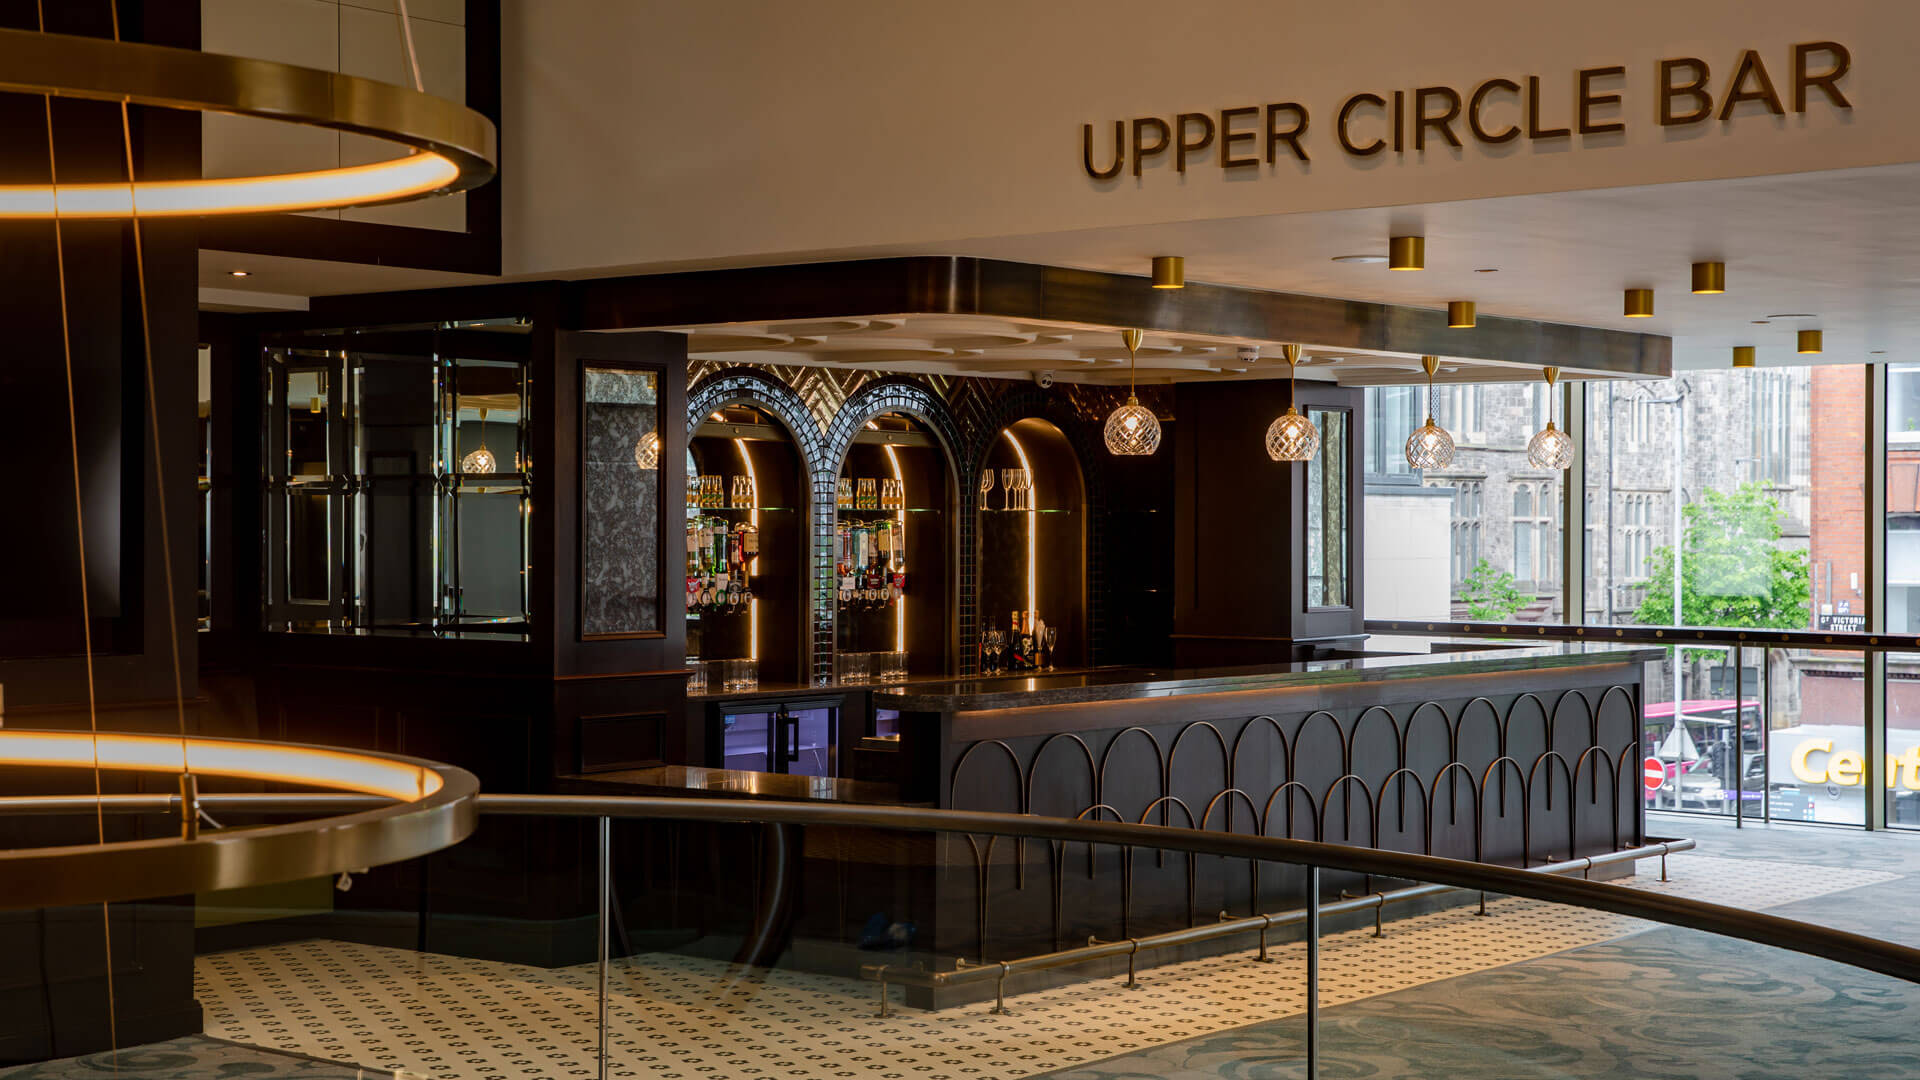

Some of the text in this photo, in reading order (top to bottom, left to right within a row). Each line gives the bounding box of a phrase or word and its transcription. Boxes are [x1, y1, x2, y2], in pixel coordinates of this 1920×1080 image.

[1083, 40, 1853, 180] UPPER CIRCLE BAR
[1833, 617, 1866, 625] VICTORIA
